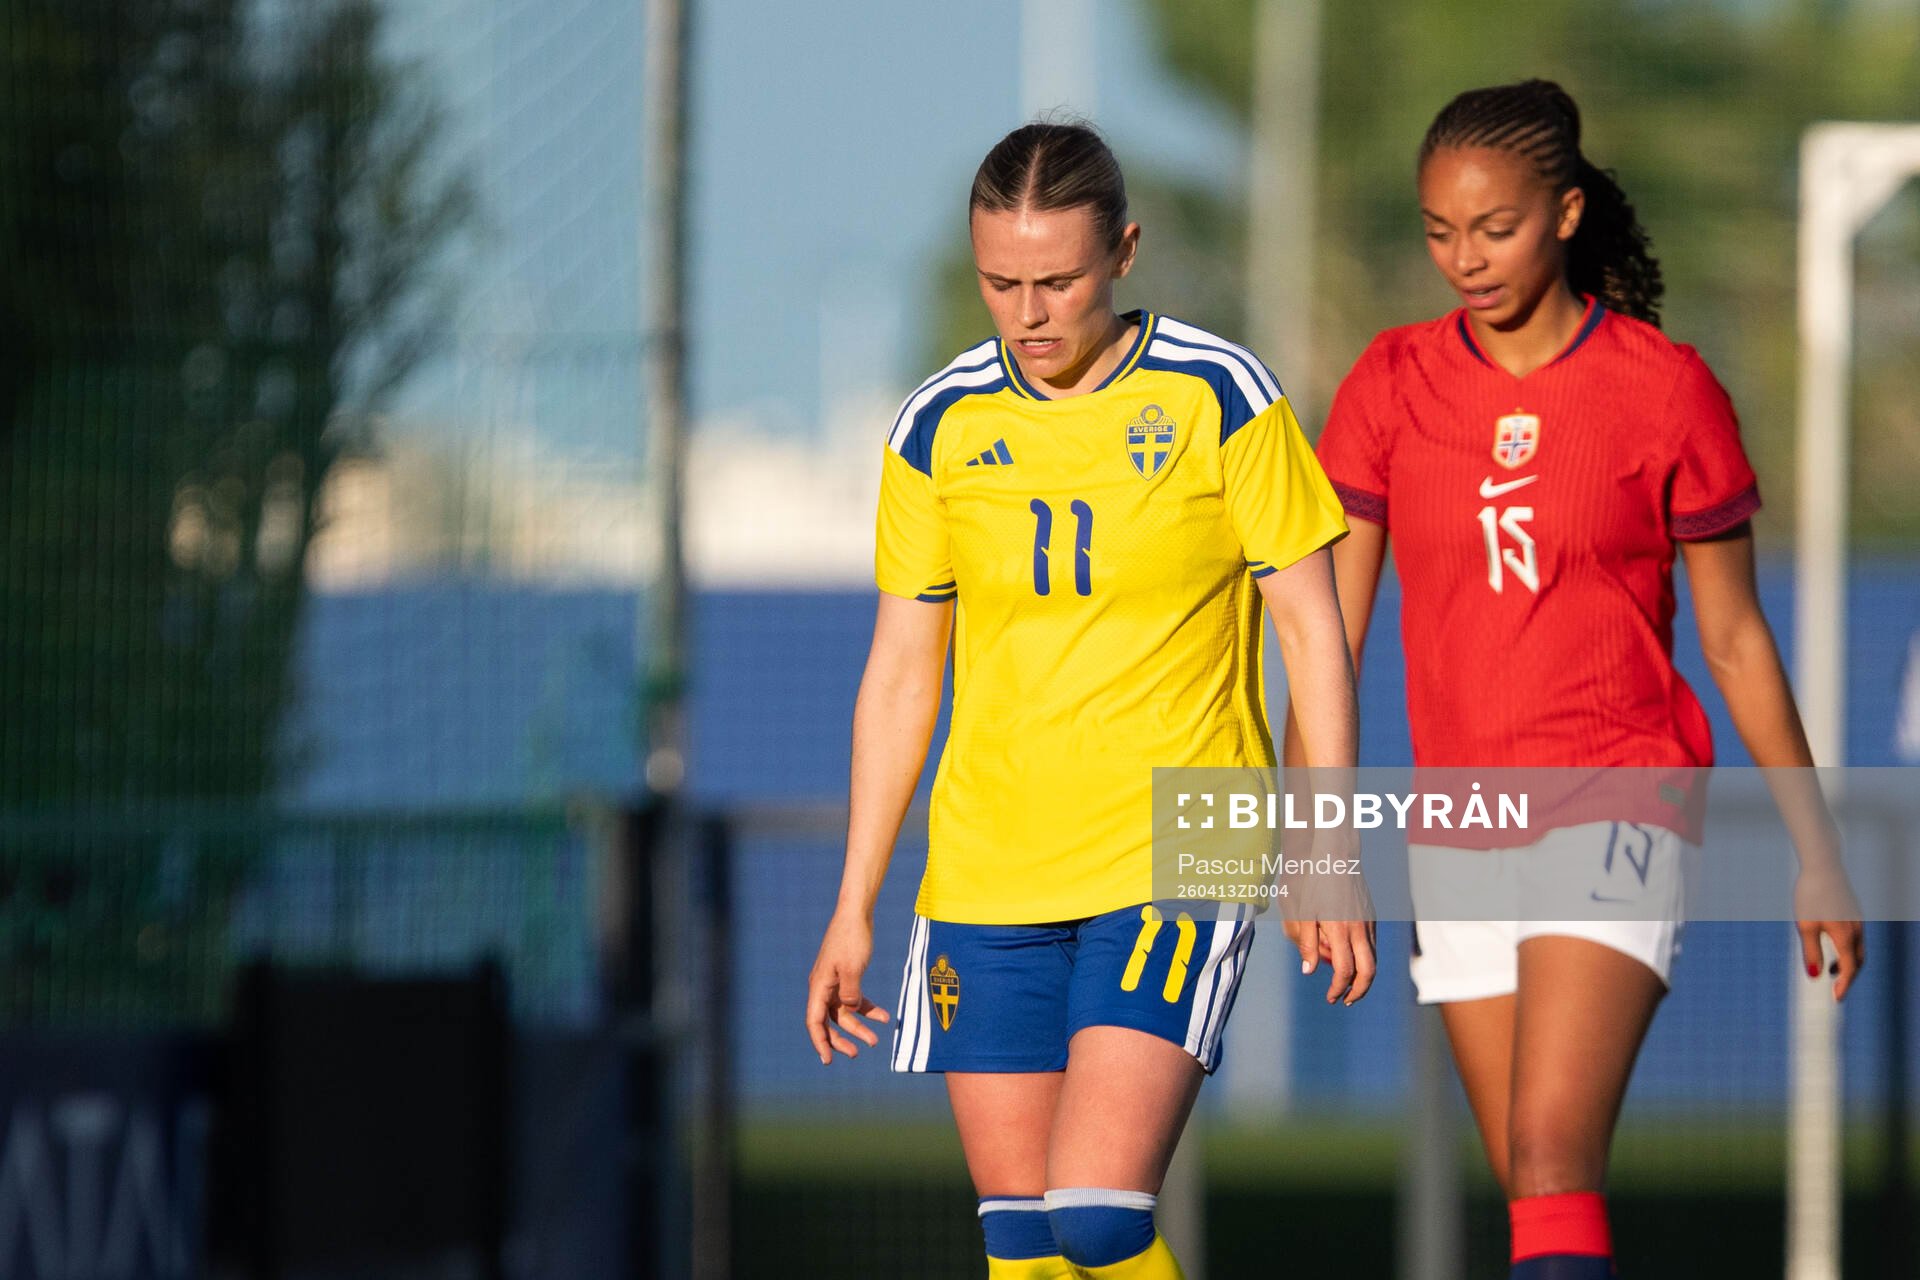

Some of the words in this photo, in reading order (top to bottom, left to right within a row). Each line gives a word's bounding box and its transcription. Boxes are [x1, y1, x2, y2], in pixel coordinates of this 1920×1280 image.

[1030, 499, 1093, 596] 11
[1477, 506, 1540, 594] 15
[1120, 905, 1197, 1004] 11
